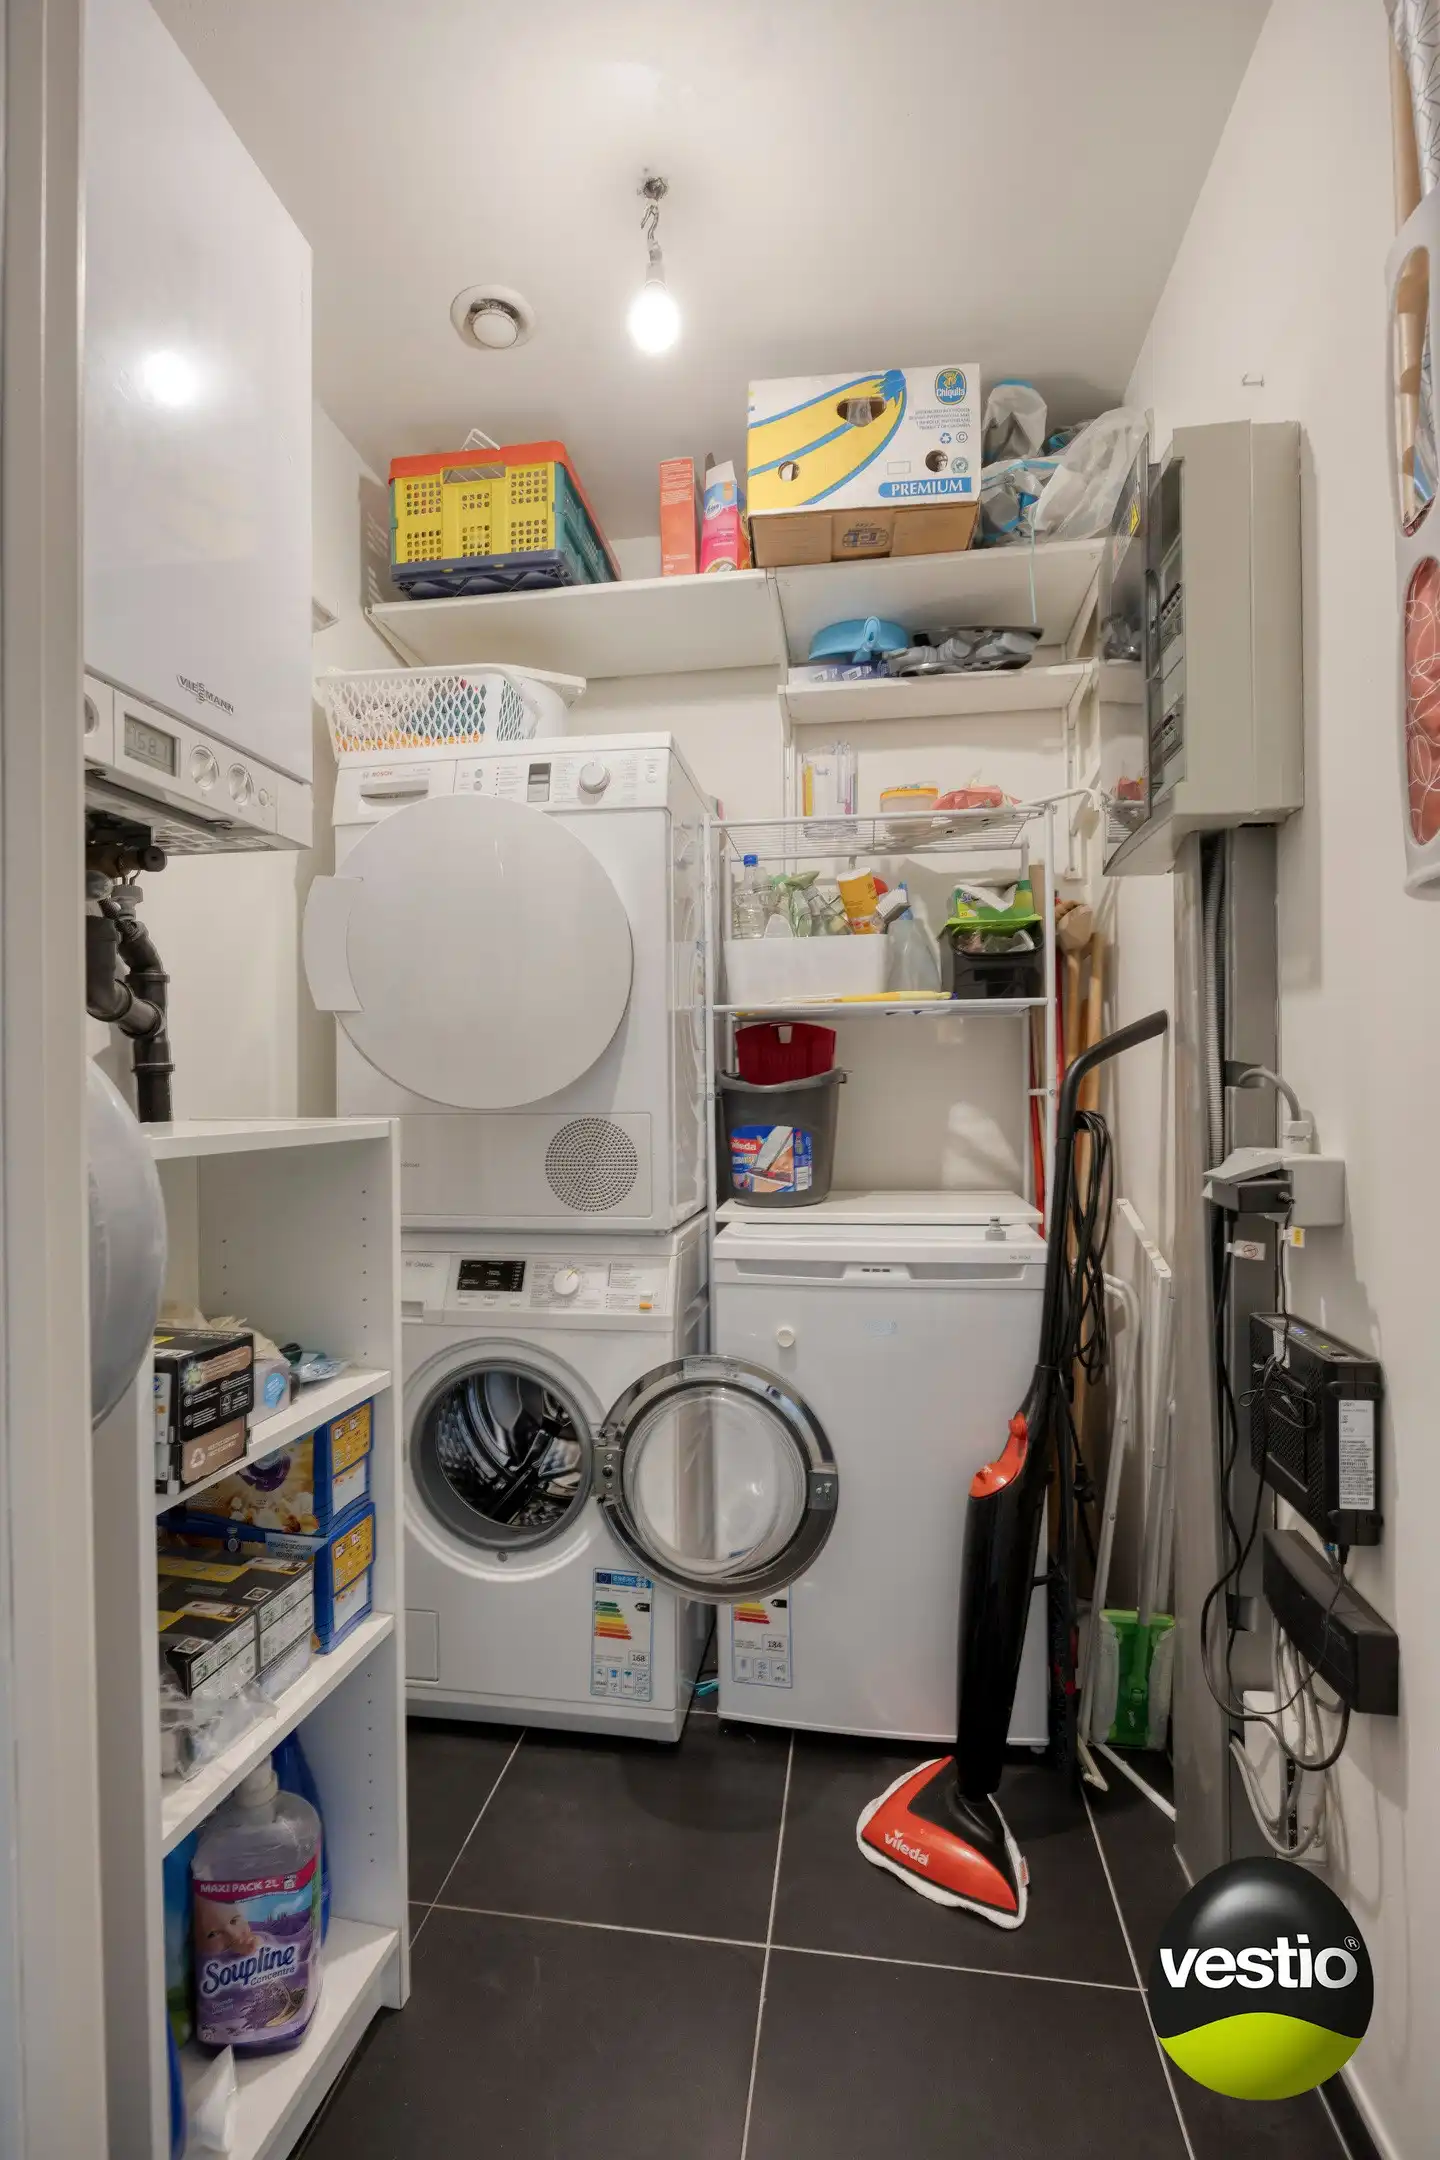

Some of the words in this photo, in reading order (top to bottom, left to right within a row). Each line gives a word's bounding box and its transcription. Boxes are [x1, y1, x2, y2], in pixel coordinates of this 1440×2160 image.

[936, 388, 966, 399] Chiquita
[891, 479, 963, 496] PREMIUM
[177, 675, 235, 715] VIESSMANN
[632, 1654, 646, 1662] 168
[884, 1829, 930, 1867] vileda
[200, 1884, 230, 1893] MAXI
[232, 1881, 262, 1893] PACK
[264, 1879, 280, 1889] 2L
[202, 1946, 295, 1994] Soupline
